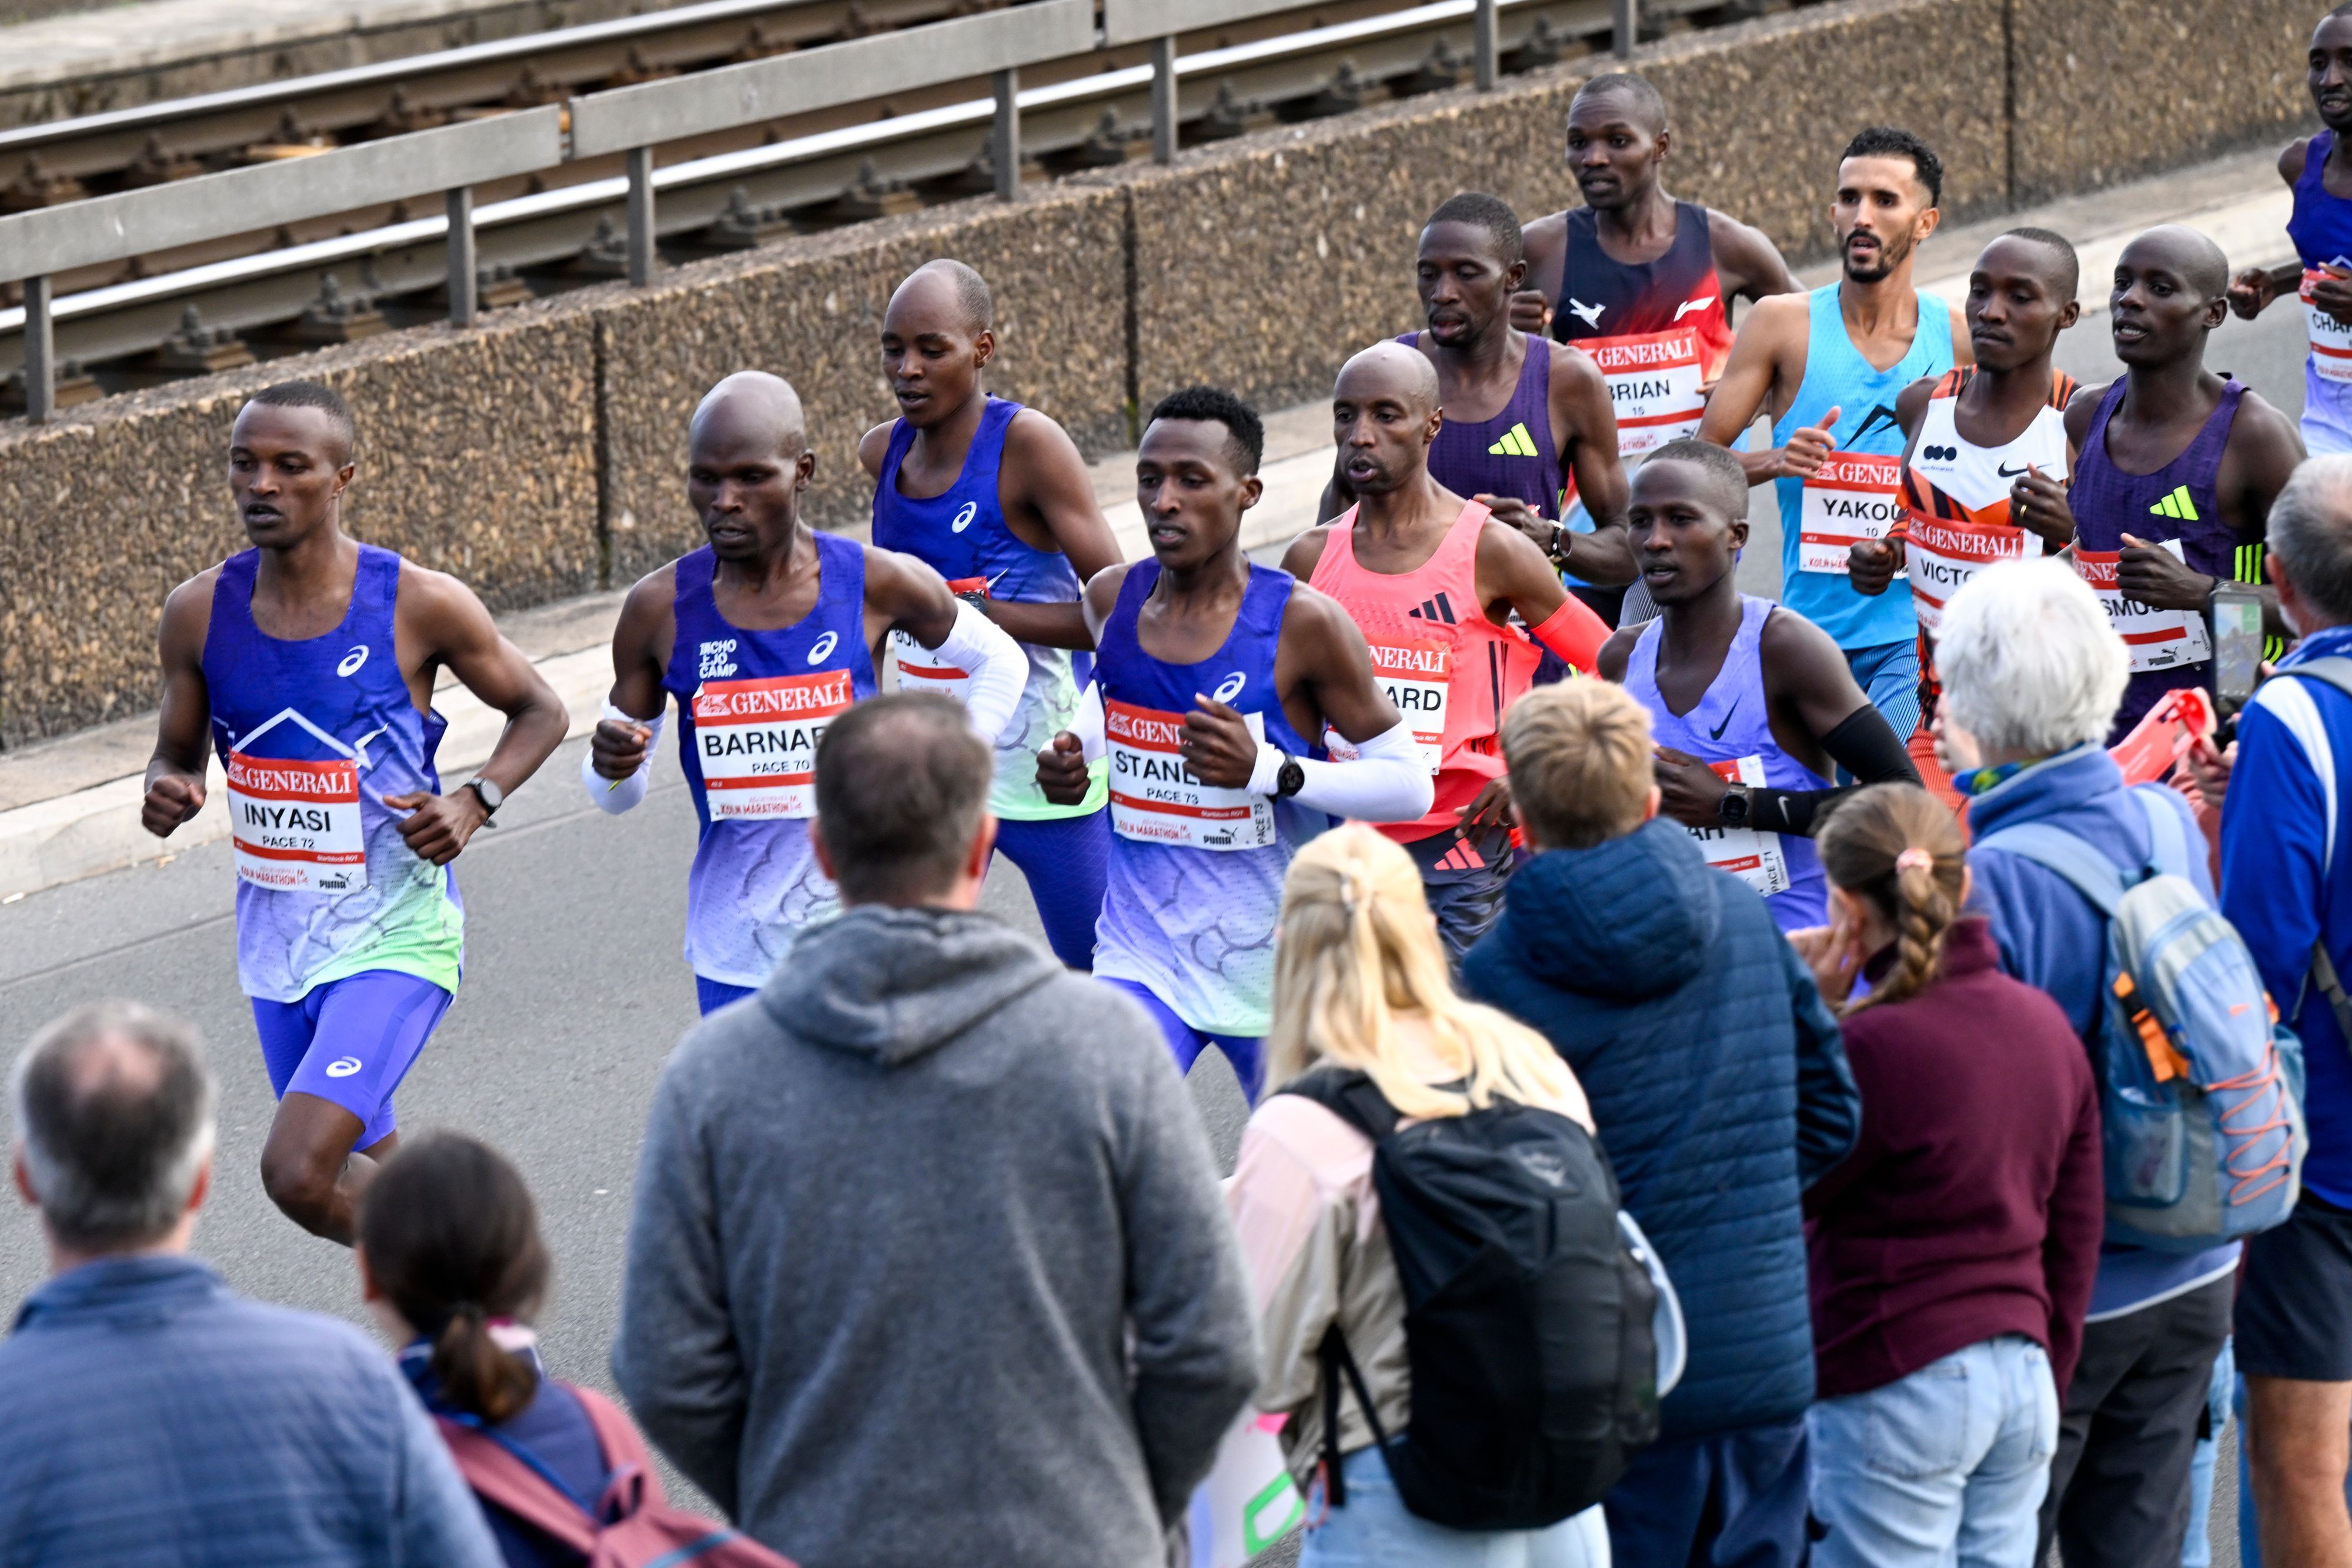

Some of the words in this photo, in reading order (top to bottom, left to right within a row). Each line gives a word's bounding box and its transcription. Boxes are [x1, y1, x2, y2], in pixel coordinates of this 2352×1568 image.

[2313, 313, 2352, 333] CHA
[1598, 337, 1694, 367] GENERALI
[1865, 527, 1878, 537] 10
[1926, 524, 2019, 557] GENERALI
[699, 663, 738, 679] CAMP
[731, 682, 847, 715] GENERALI
[753, 761, 789, 774] PACE
[794, 760, 810, 771] 70
[246, 767, 352, 795] GENERALI
[1146, 788, 1182, 803] PACE
[1185, 793, 1199, 805] 73
[245, 803, 331, 832] INYASI
[262, 835, 297, 848] PACE
[301, 838, 315, 849] 72
[1255, 818, 1267, 844] PACE
[1763, 851, 1775, 862] 71
[1766, 866, 1780, 892] PACE
